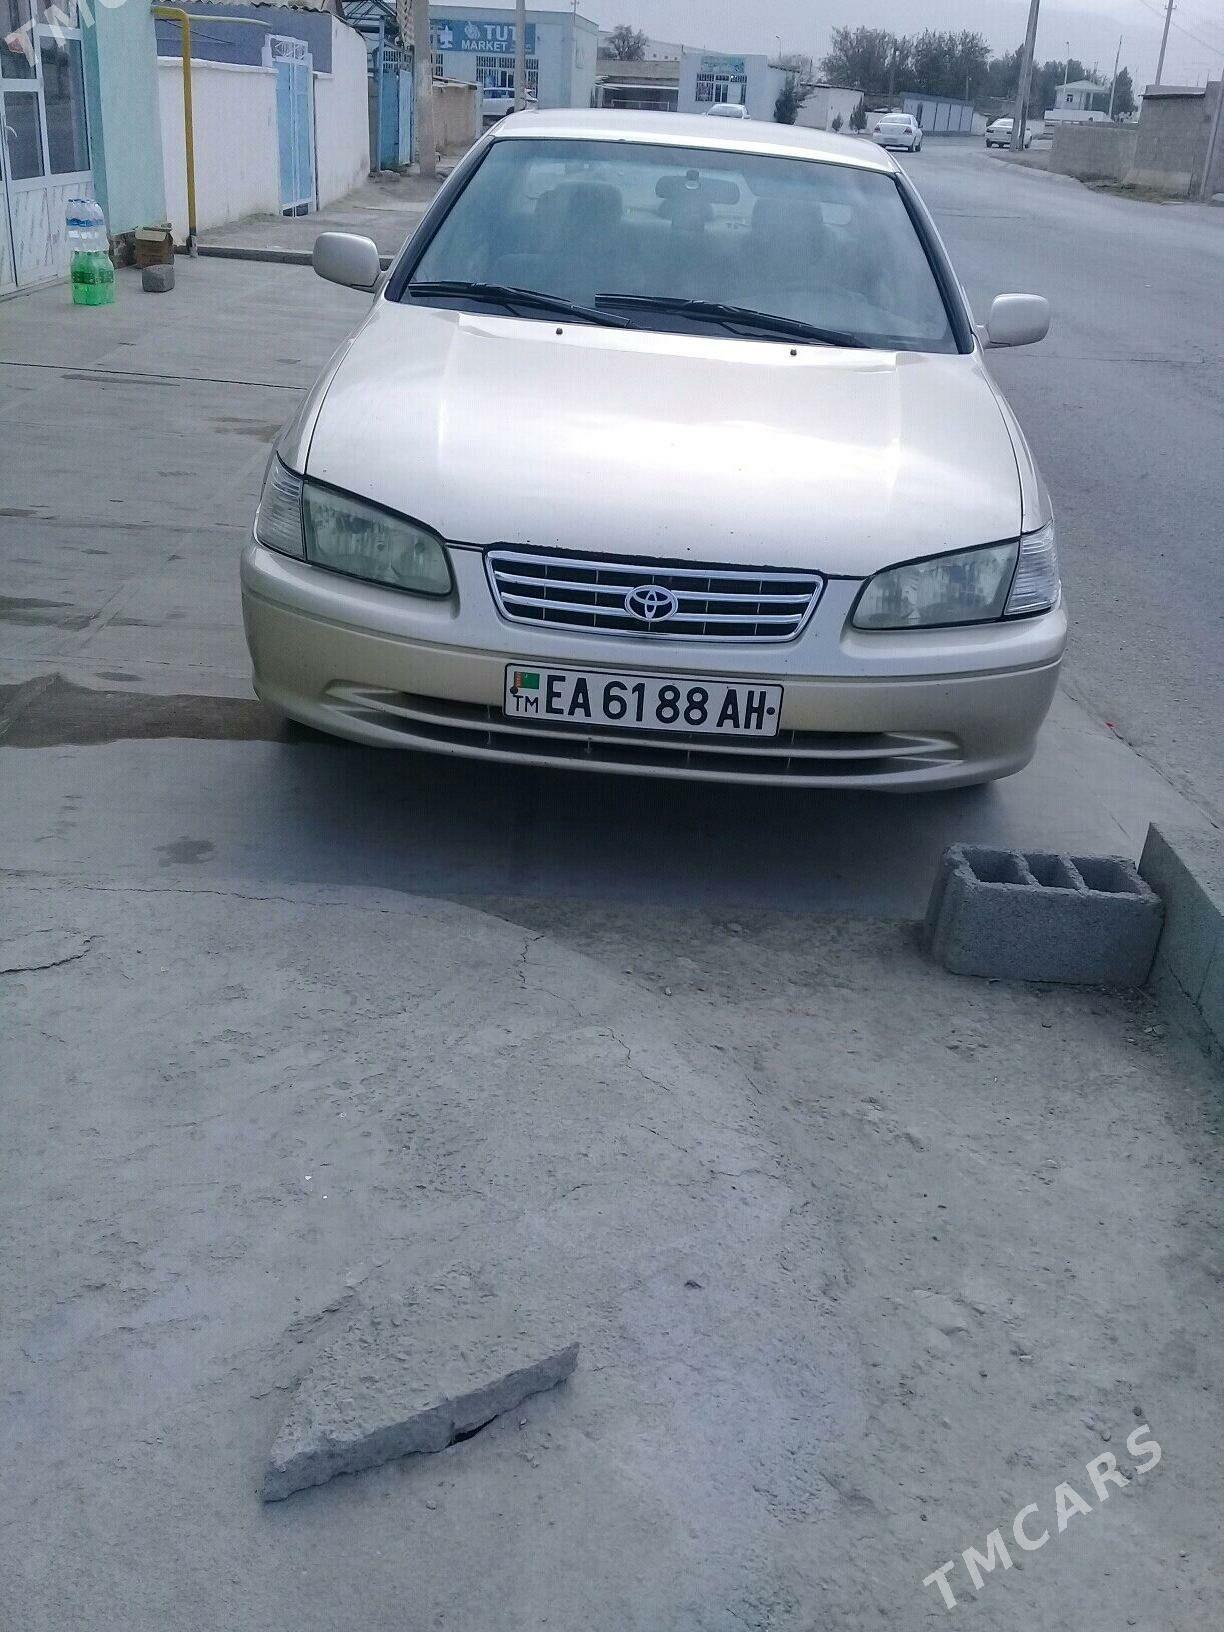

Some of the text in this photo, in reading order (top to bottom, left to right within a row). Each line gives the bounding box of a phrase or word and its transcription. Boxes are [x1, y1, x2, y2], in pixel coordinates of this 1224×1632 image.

[461, 39, 508, 52] MARKET
[512, 694, 539, 714] TM
[602, 680, 710, 726] 6188
